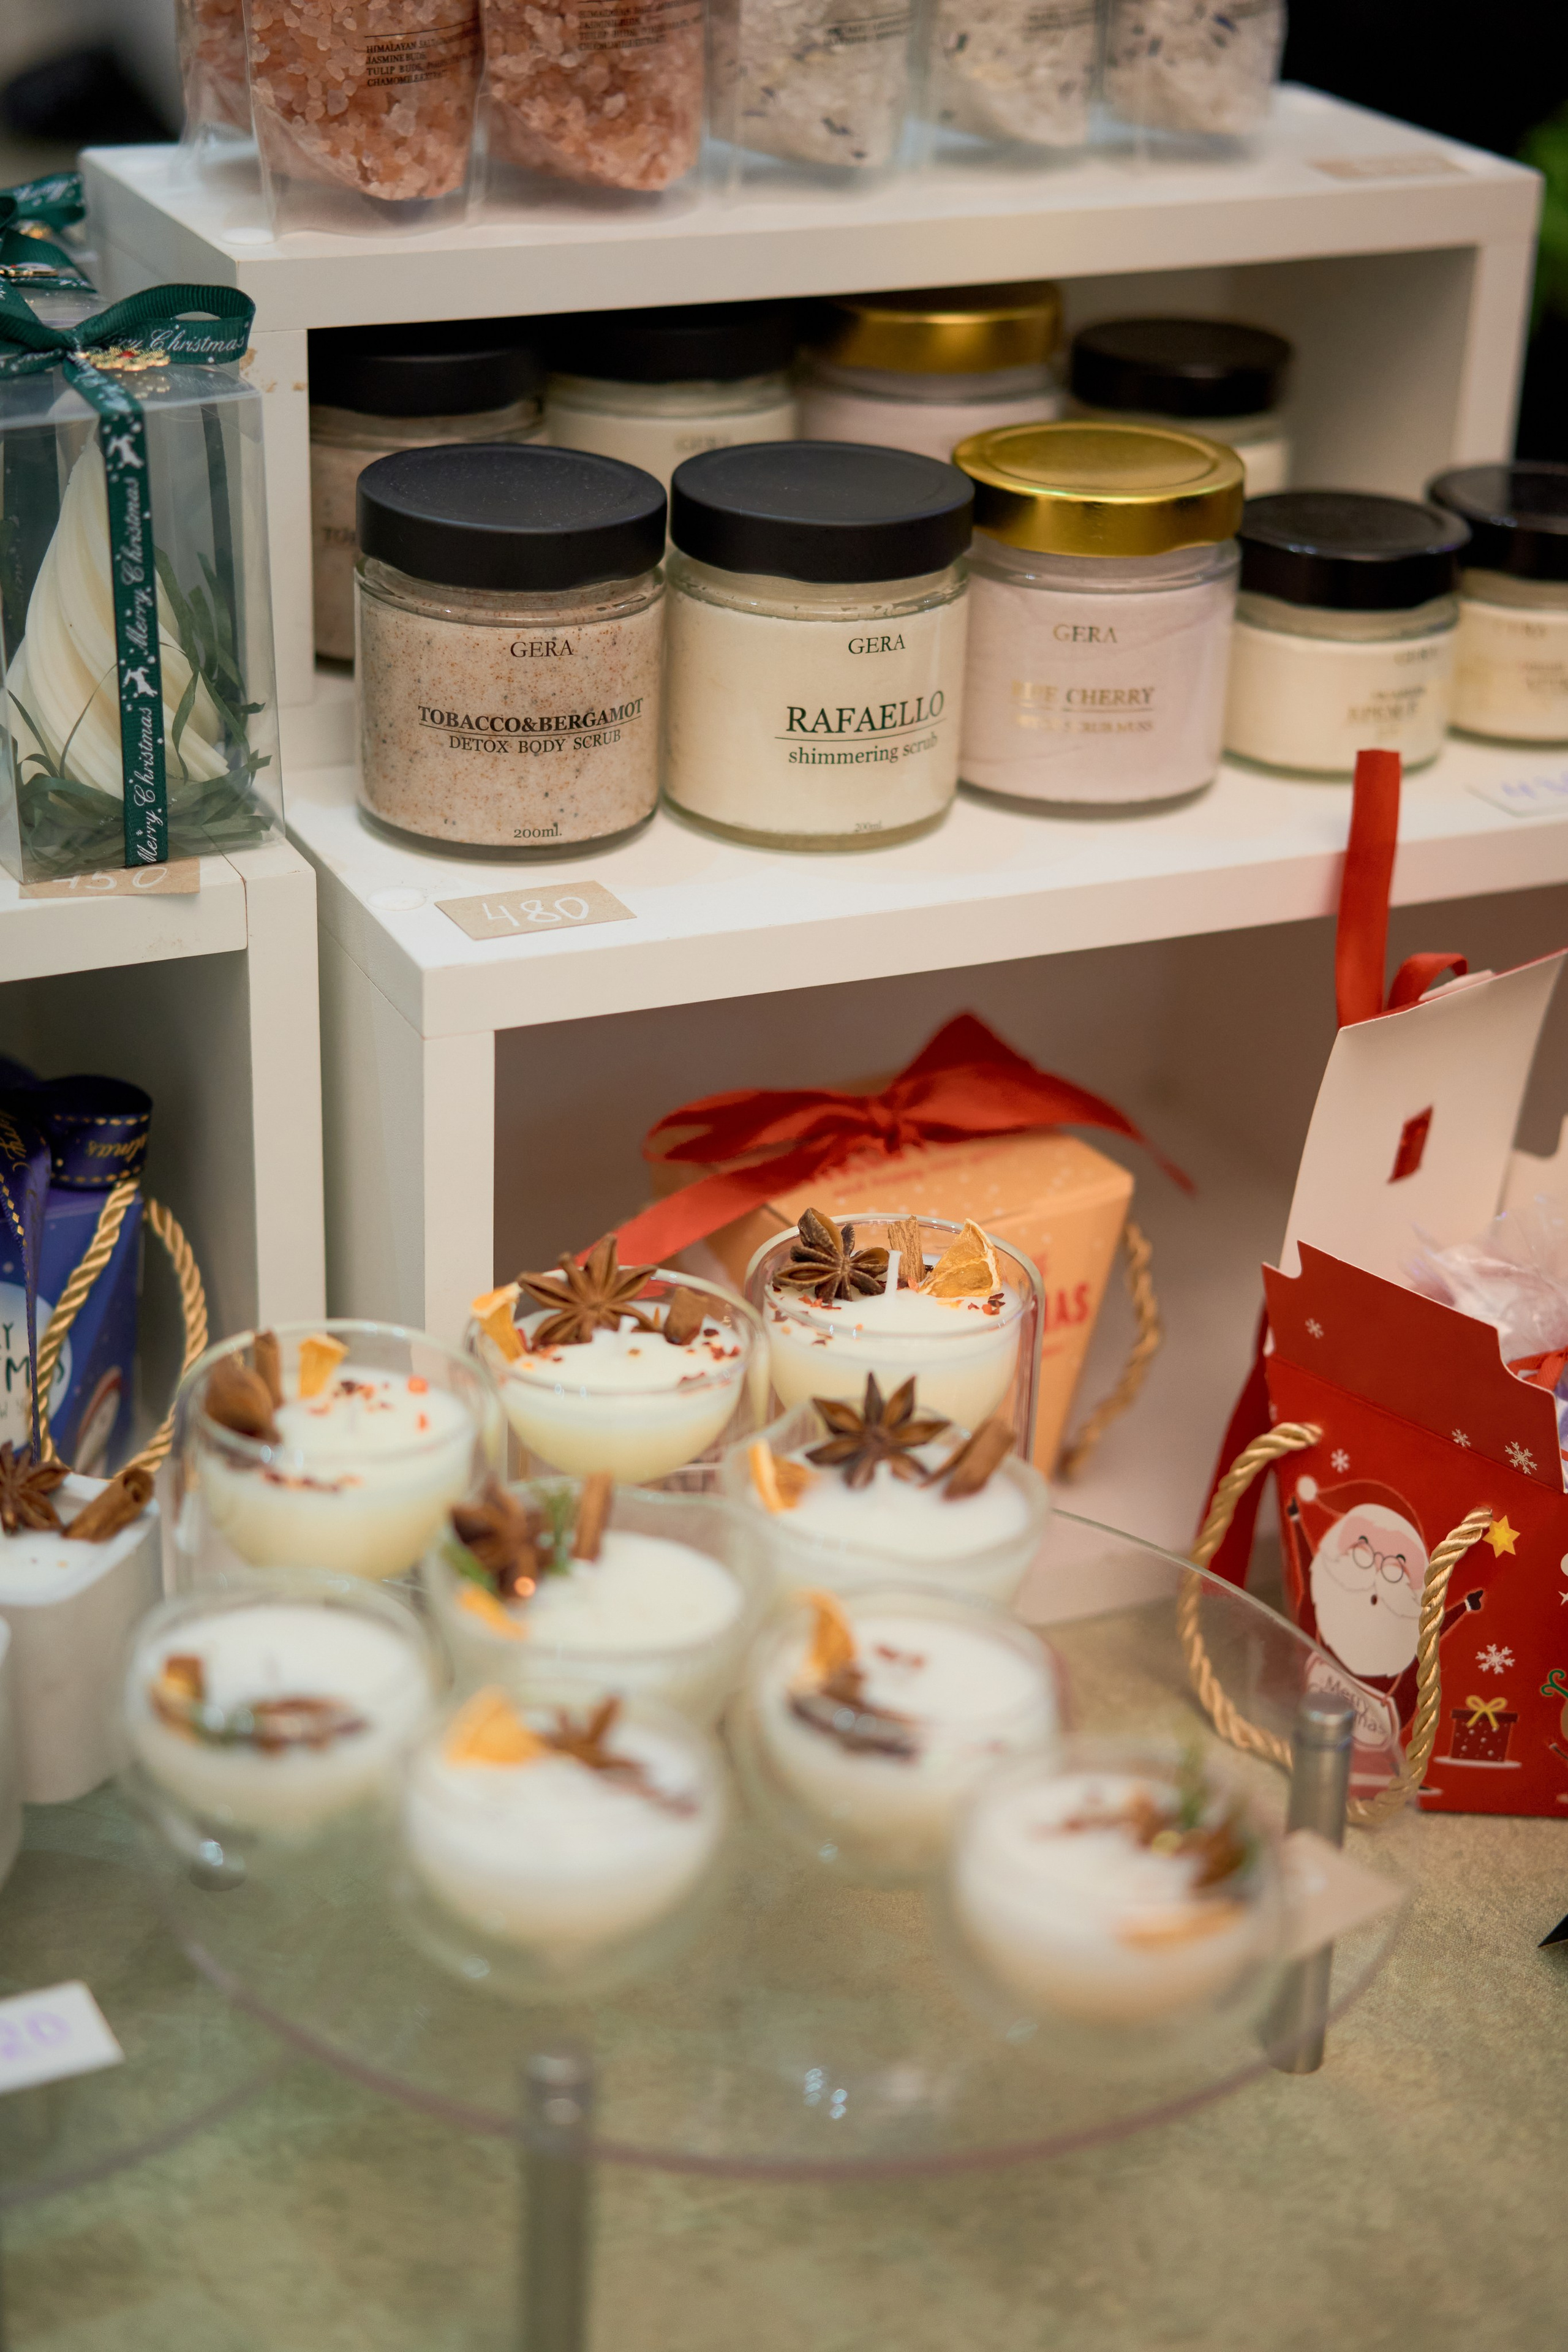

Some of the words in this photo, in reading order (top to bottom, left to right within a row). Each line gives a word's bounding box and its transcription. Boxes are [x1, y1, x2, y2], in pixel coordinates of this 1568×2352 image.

[366, 41, 417, 54] HIMALAYAN
[366, 55, 403, 65] JASMINE
[366, 66, 395, 76] TULIP
[149, 329, 245, 353] Christmas
[121, 476, 145, 585] Christmas
[126, 588, 153, 650] Merry
[848, 633, 907, 655] GERA
[1052, 624, 1119, 644] GERA
[510, 639, 575, 658] GERA
[1065, 685, 1156, 706] CHERRY
[418, 697, 644, 733] TOBACCO&BERGAMOT
[786, 690, 945, 734] RAFAELLO
[448, 735, 509, 754] DETOX
[518, 739, 567, 756] BODY
[573, 729, 622, 751] SCRUB
[788, 745, 899, 766] shimmering
[902, 733, 938, 758] scrub
[134, 706, 156, 807] Christmas
[136, 811, 164, 864] Merry
[513, 824, 563, 839] 200ml.
[481, 895, 590, 927] 480
